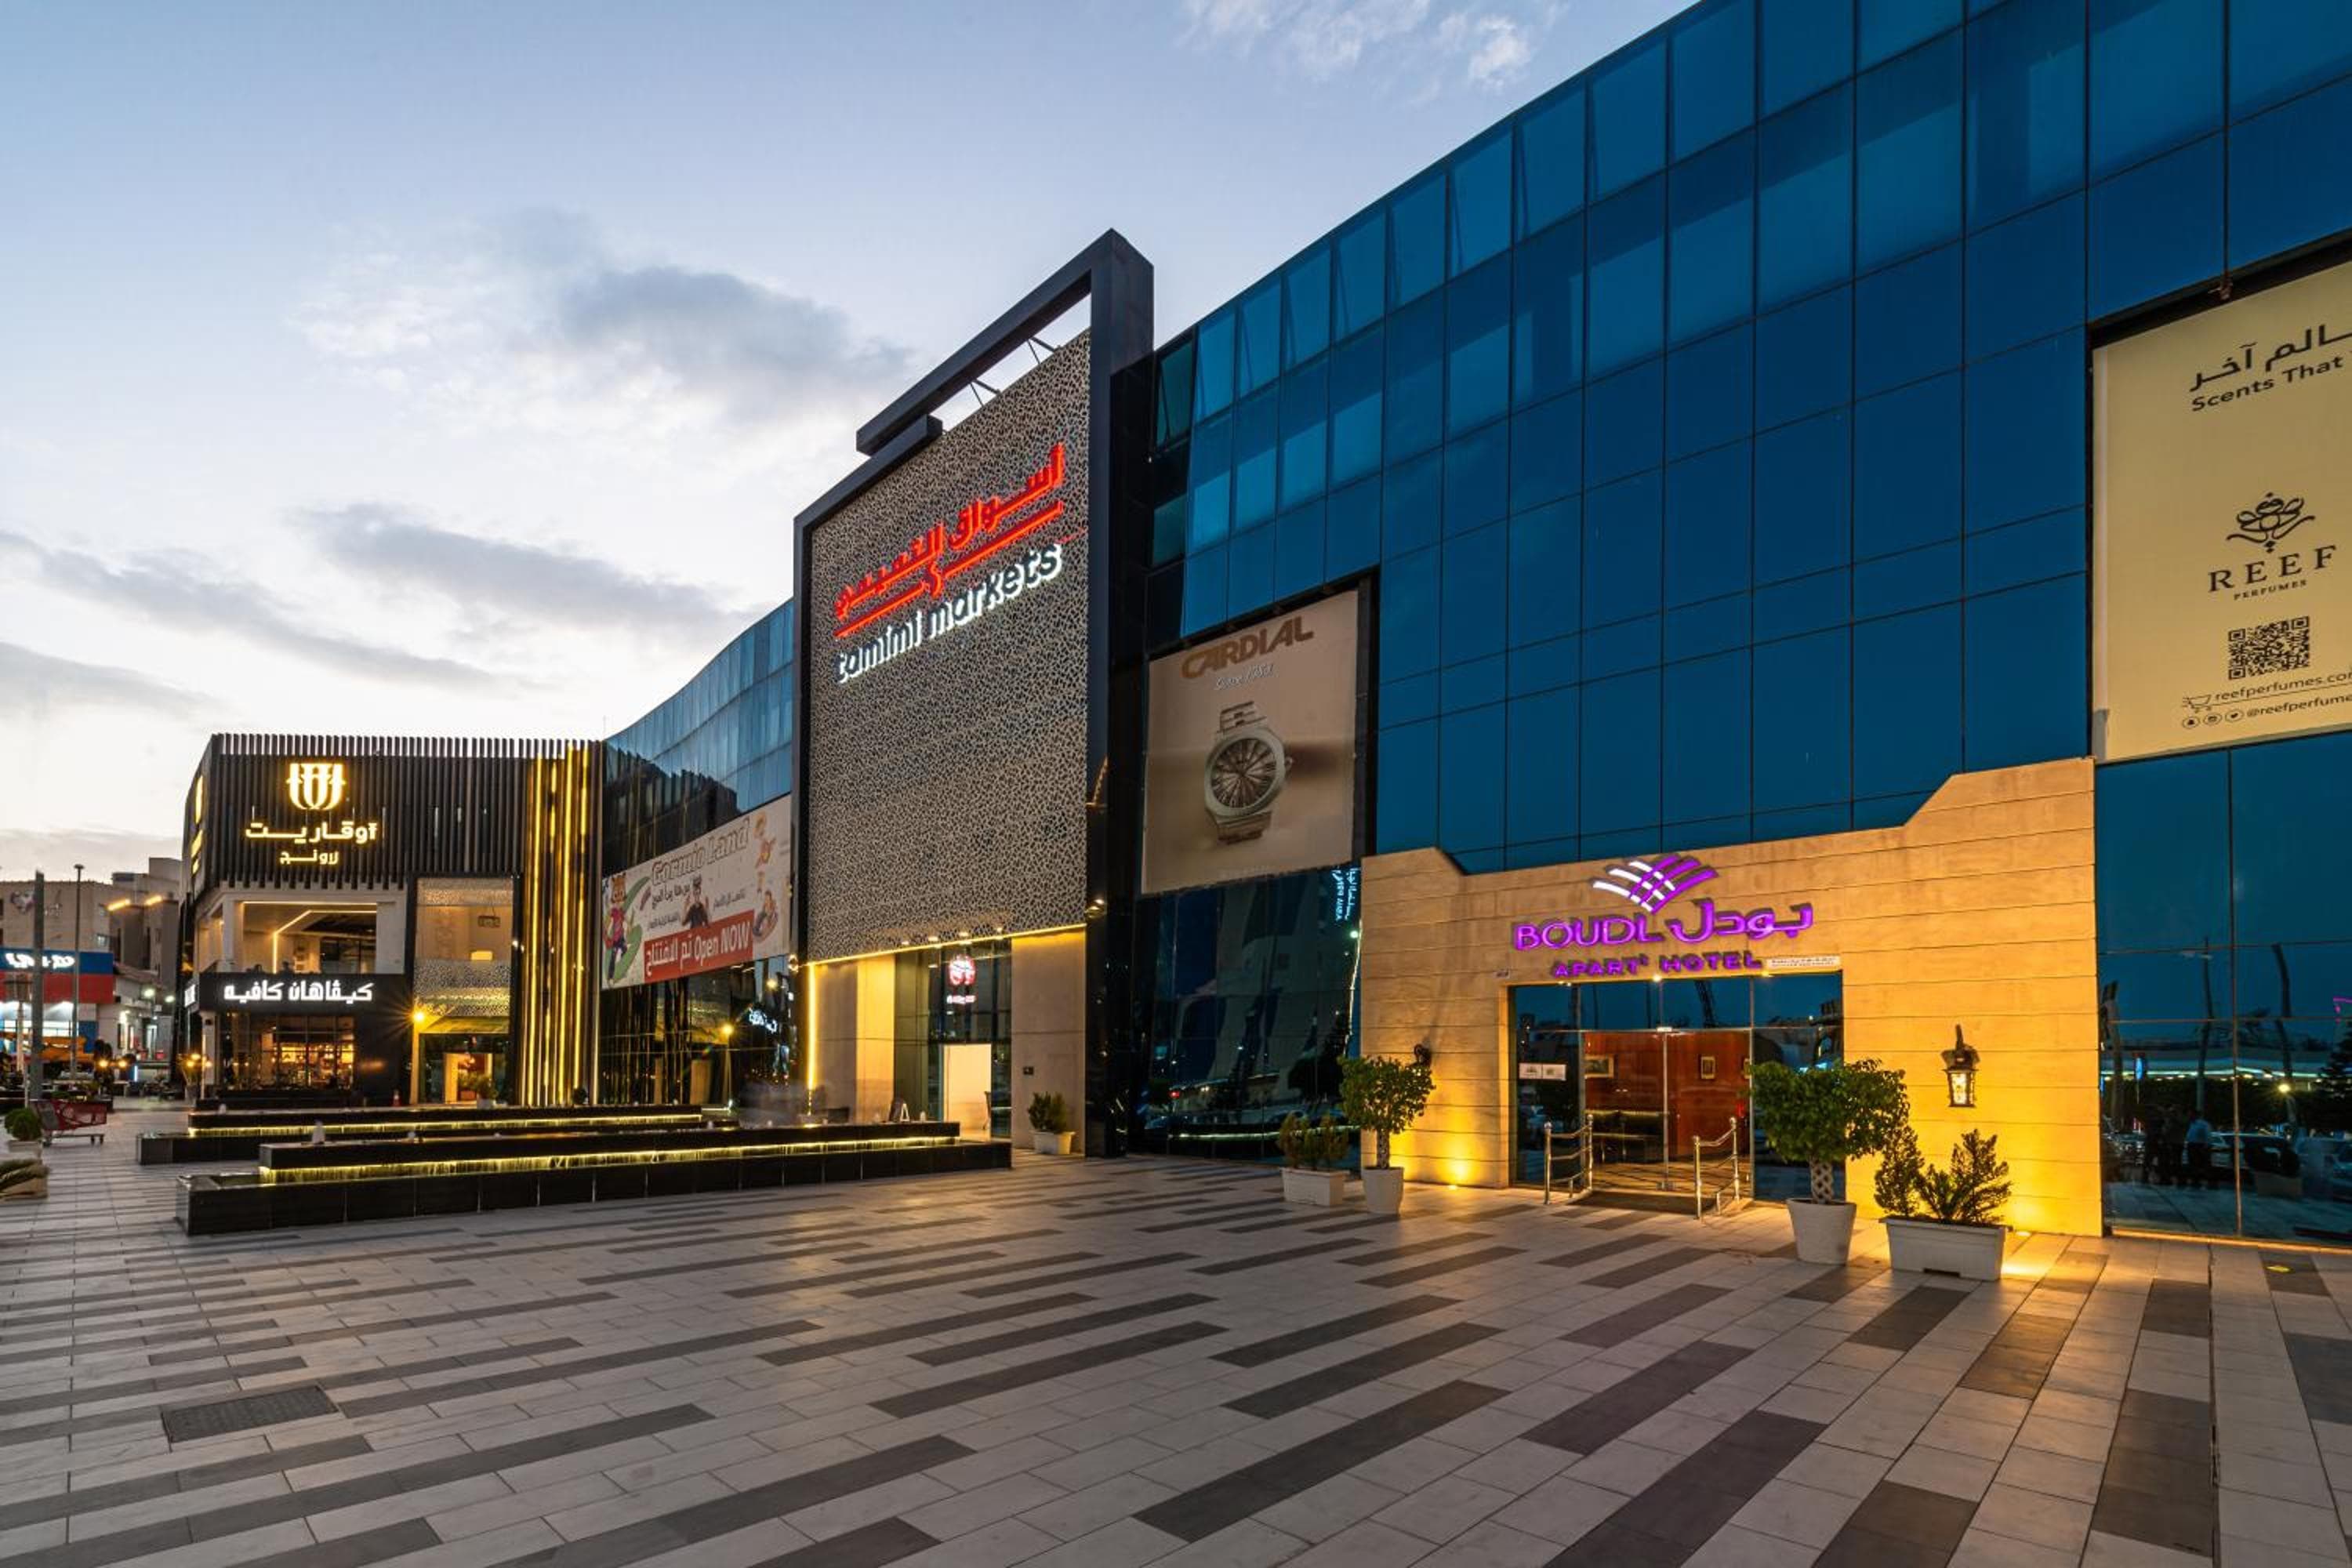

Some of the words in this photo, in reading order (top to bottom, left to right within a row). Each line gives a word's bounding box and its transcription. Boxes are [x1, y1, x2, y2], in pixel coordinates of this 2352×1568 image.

[2189, 342, 2256, 392] آخر
[2191, 378, 2274, 412] Scents
[2281, 356, 2343, 383] That
[927, 543, 1062, 640] markets
[2207, 545, 2337, 593] REEF
[2234, 579, 2307, 601] PERFUMES
[1181, 615, 1315, 679] CARDIAL
[695, 935, 719, 966] Open
[720, 921, 750, 953] NOW
[1515, 914, 1664, 951] BOUDL
[1669, 898, 1813, 944] بودل
[1658, 950, 1764, 974] HOTEL
[223, 980, 284, 1003] كافيه
